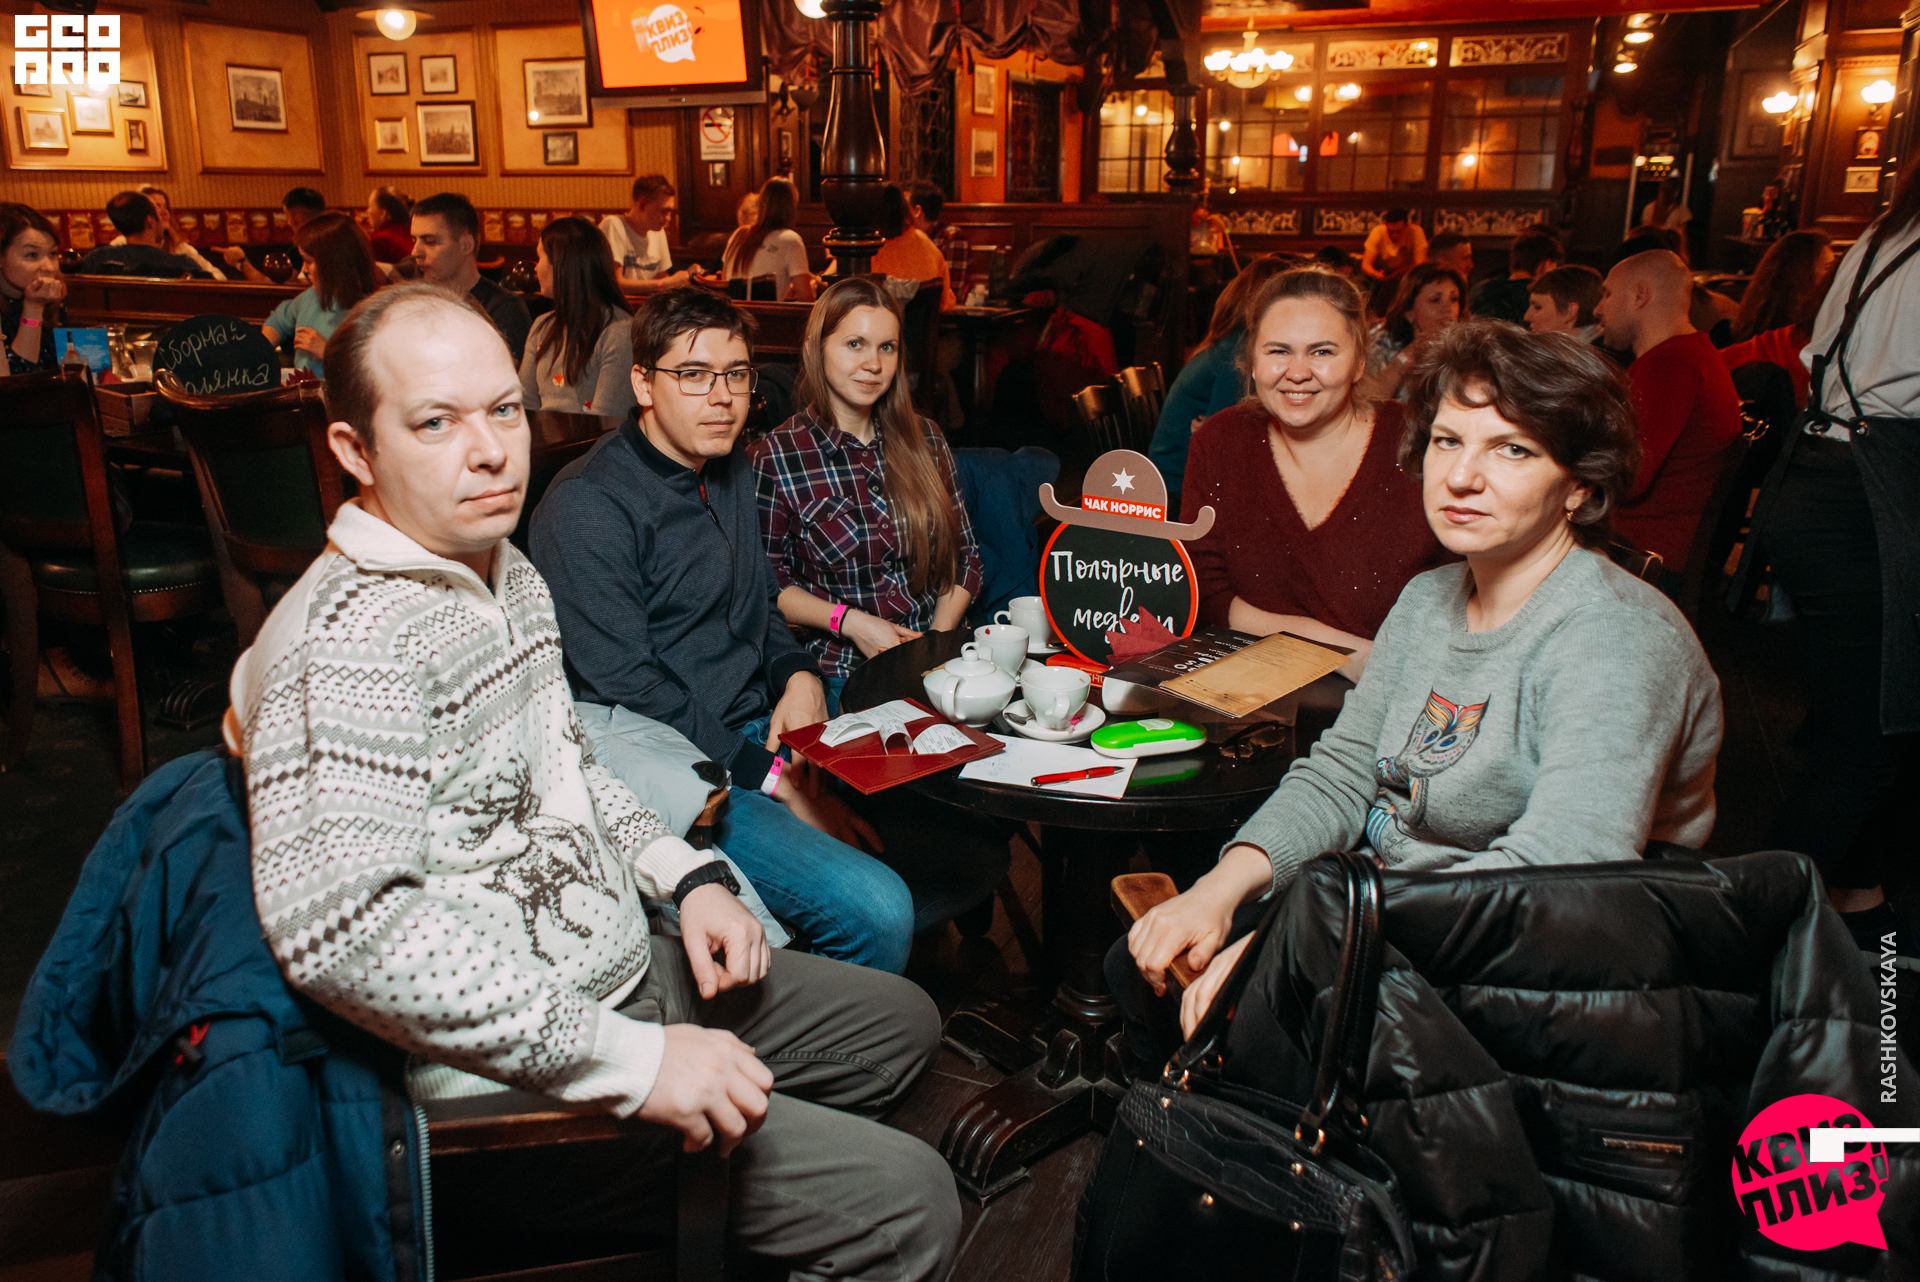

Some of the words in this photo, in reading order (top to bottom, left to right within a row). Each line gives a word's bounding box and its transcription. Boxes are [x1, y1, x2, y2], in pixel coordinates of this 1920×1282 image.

[185, 363, 270, 395] олянка
[1084, 498, 1109, 512] ЧАК
[1110, 501, 1162, 519] НОРРИС
[1050, 551, 1184, 588] Полярные
[1073, 586, 1175, 644] медвеи
